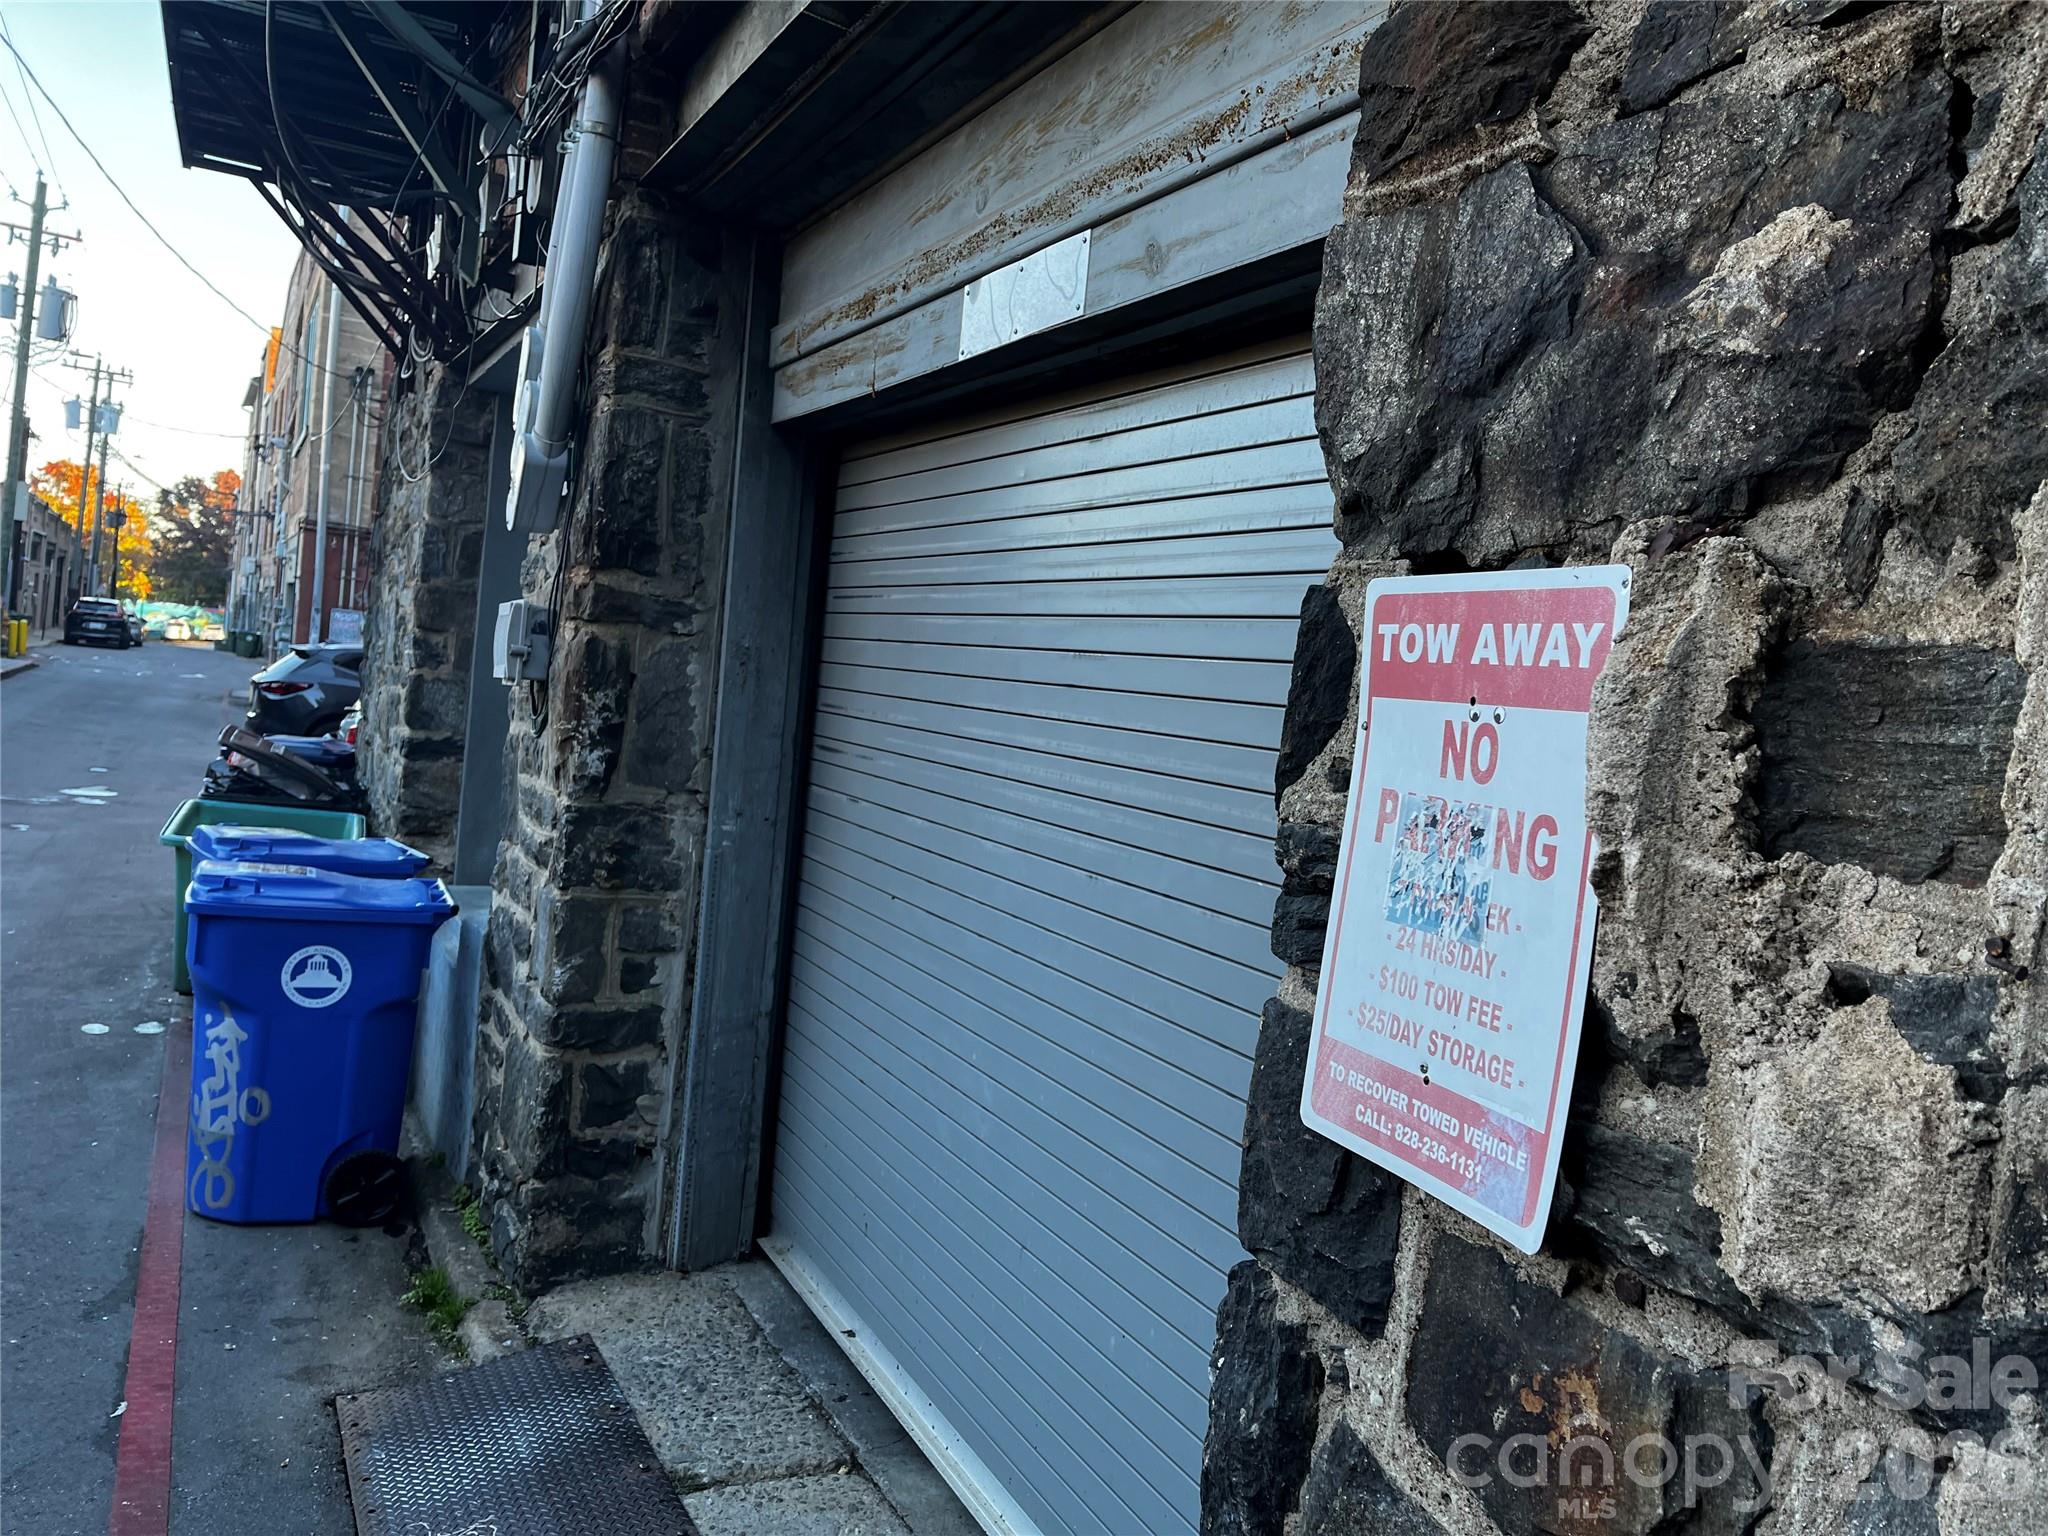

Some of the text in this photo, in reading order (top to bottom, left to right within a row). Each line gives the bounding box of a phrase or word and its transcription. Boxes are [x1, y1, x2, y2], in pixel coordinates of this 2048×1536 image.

[1378, 623, 1605, 668] TOW AWAY
[1440, 720, 1499, 785] NO
[1395, 927, 1416, 954] 24
[1379, 964, 1503, 1033] $100 TOW FEE
[1357, 1002, 1514, 1089] $25/DAY STORAGE
[1329, 1061, 1527, 1172] TO RECOVER TOWED VEHICLE
[1355, 1104, 1482, 1183] CALL: 828-236-1131
